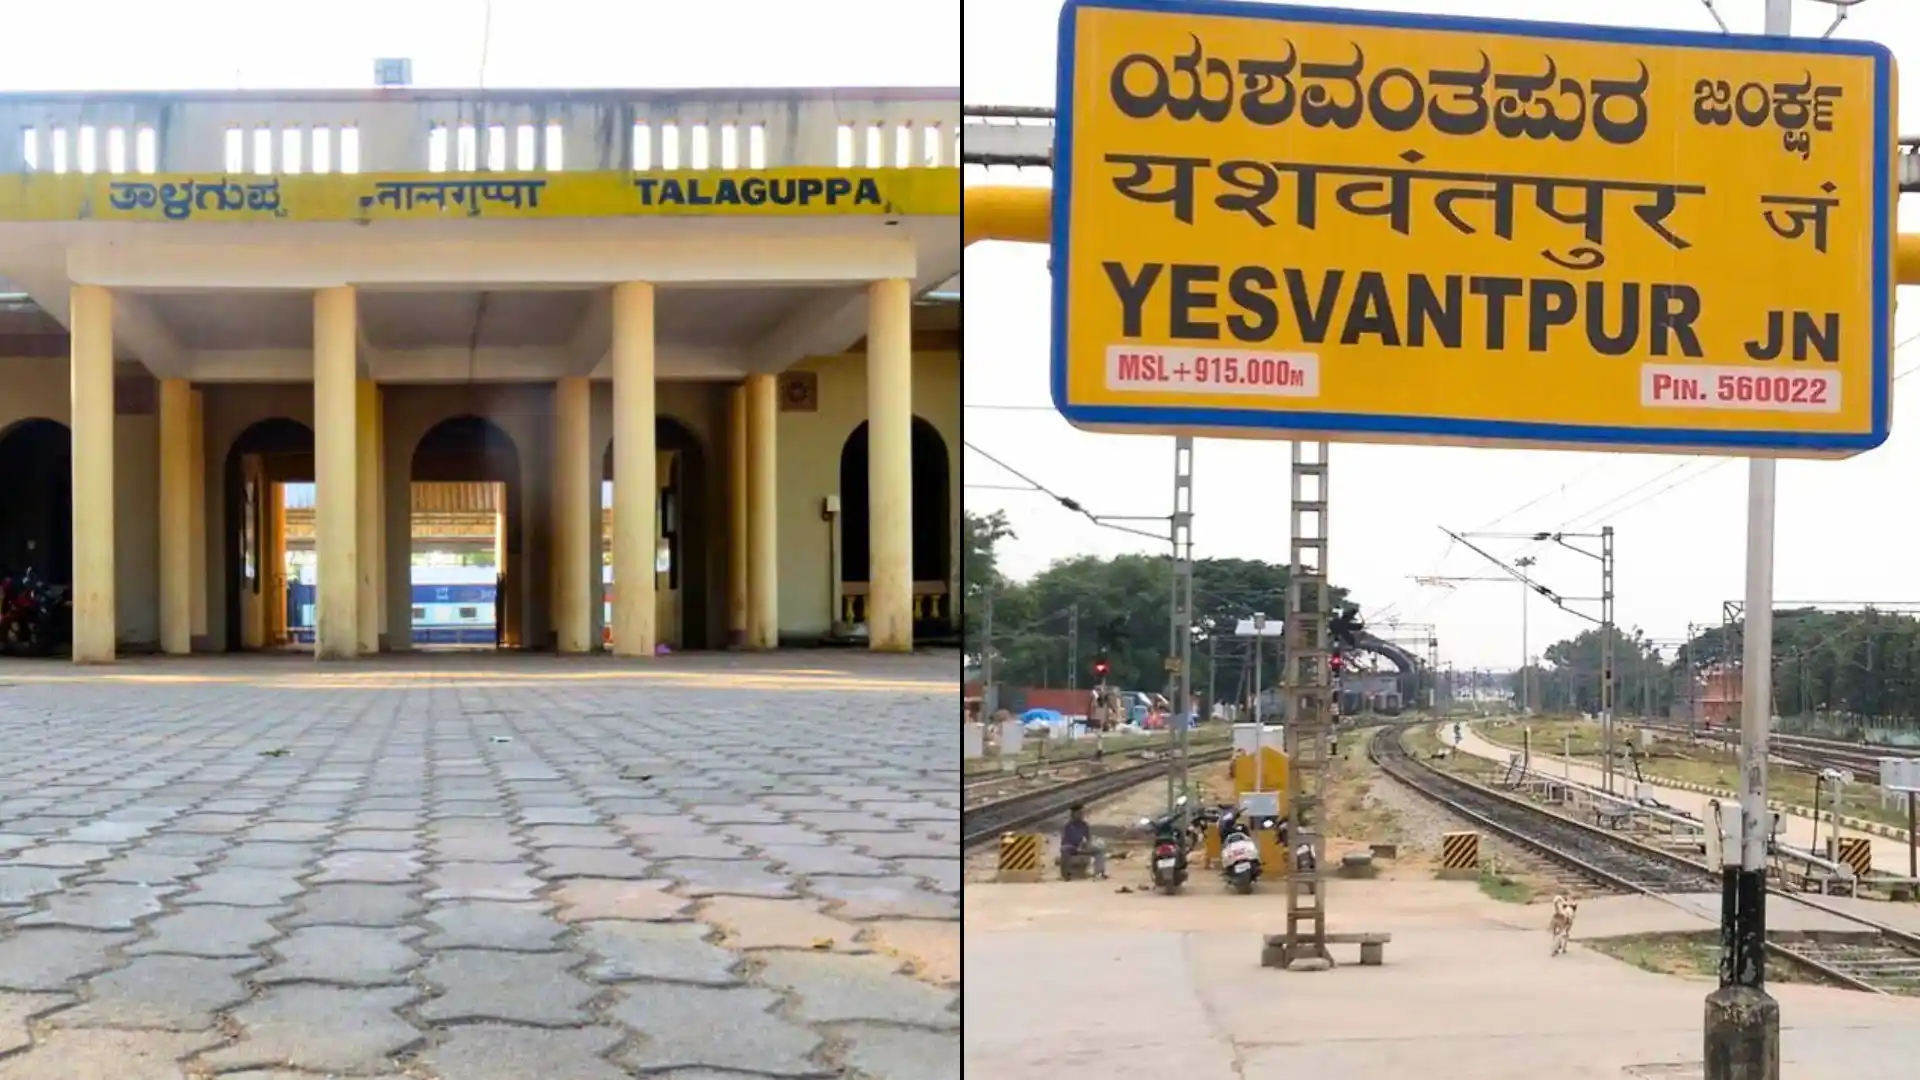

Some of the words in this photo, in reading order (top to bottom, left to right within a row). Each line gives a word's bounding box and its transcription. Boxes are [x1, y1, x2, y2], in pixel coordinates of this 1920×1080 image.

[1110, 31, 1649, 144] ಯಶವಂತಪುರ
[634, 177, 882, 206] TALAGUPPA
[1104, 149, 1705, 270] यशवंतपुर
[1762, 181, 1839, 254] जं
[1102, 261, 1703, 358] YESVANTPUR
[1744, 310, 1840, 362] JN
[1717, 375, 1827, 404] 560022
